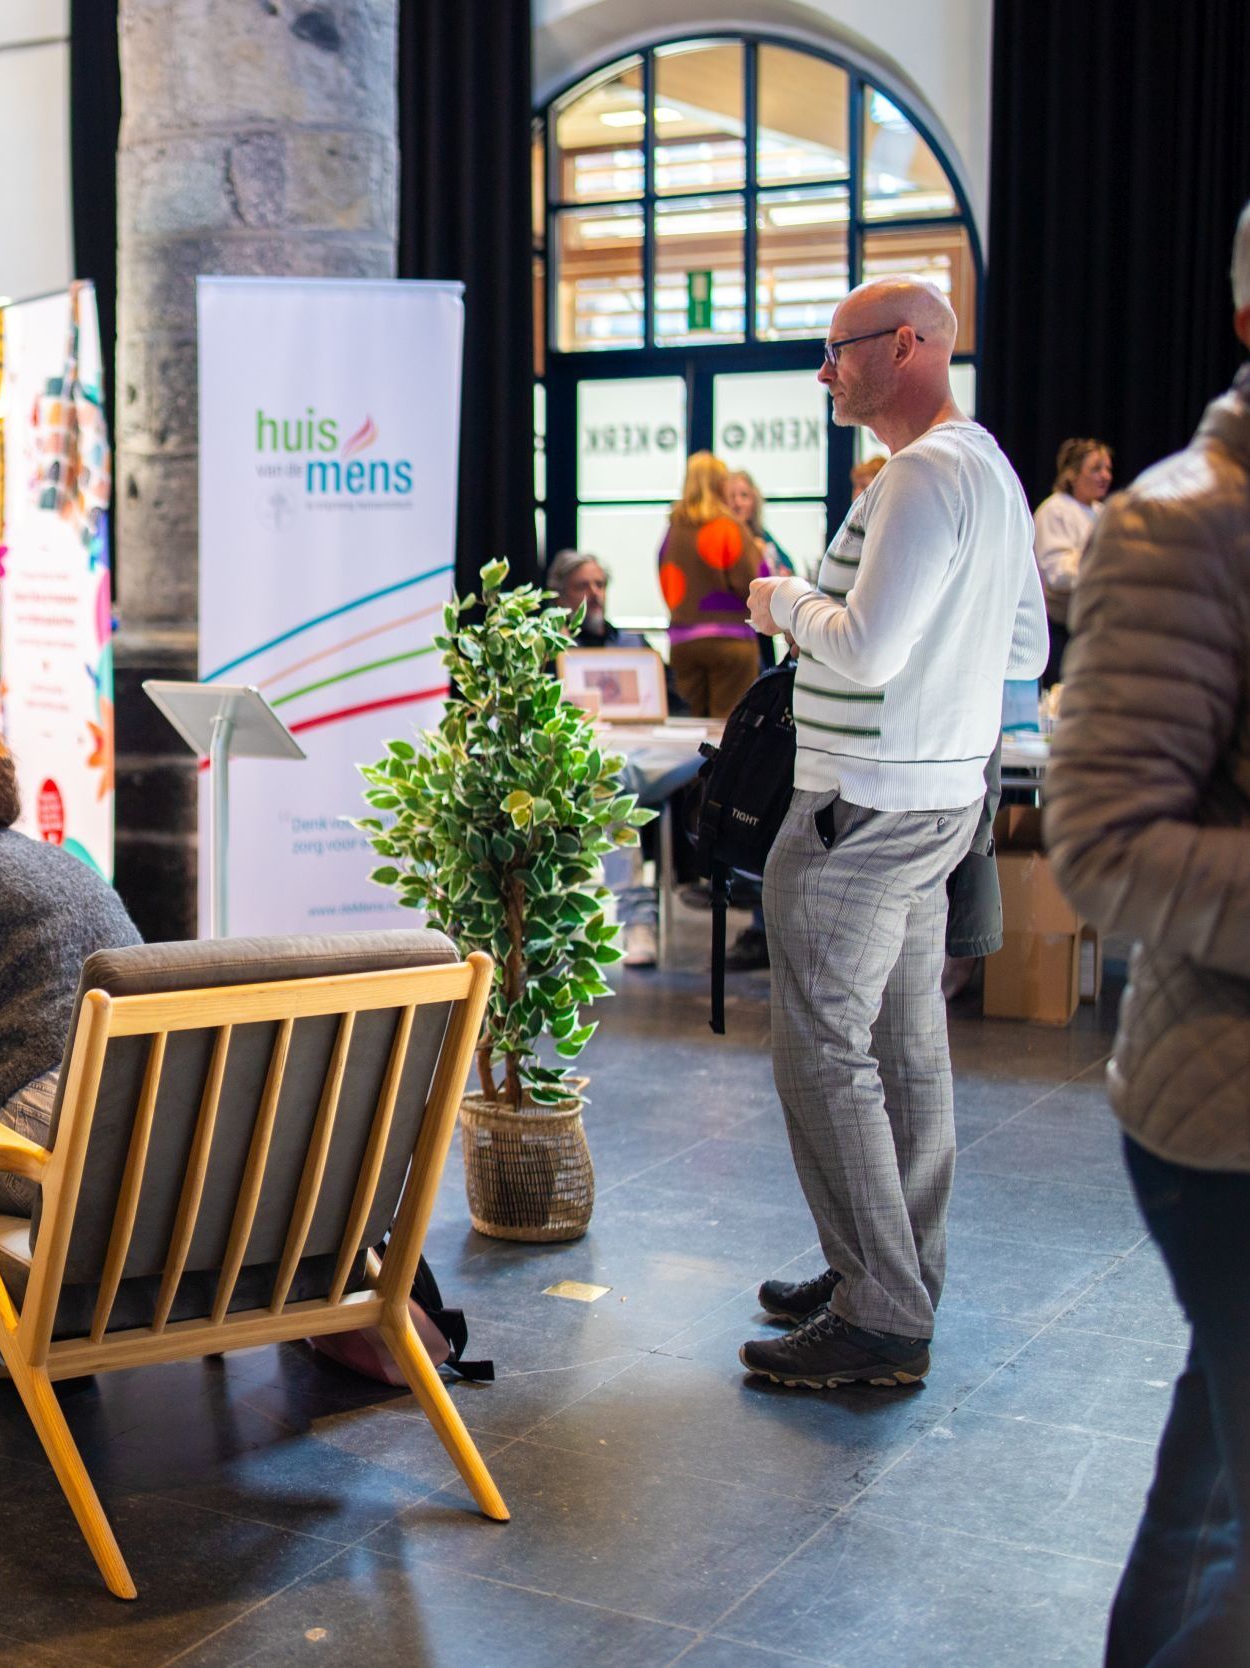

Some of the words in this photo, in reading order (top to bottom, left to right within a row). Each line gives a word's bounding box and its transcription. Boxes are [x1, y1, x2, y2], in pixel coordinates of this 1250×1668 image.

[257, 407, 338, 452] huis
[306, 460, 413, 494] mens
[732, 808, 759, 827] TIGHT
[325, 836, 356, 852] voor
